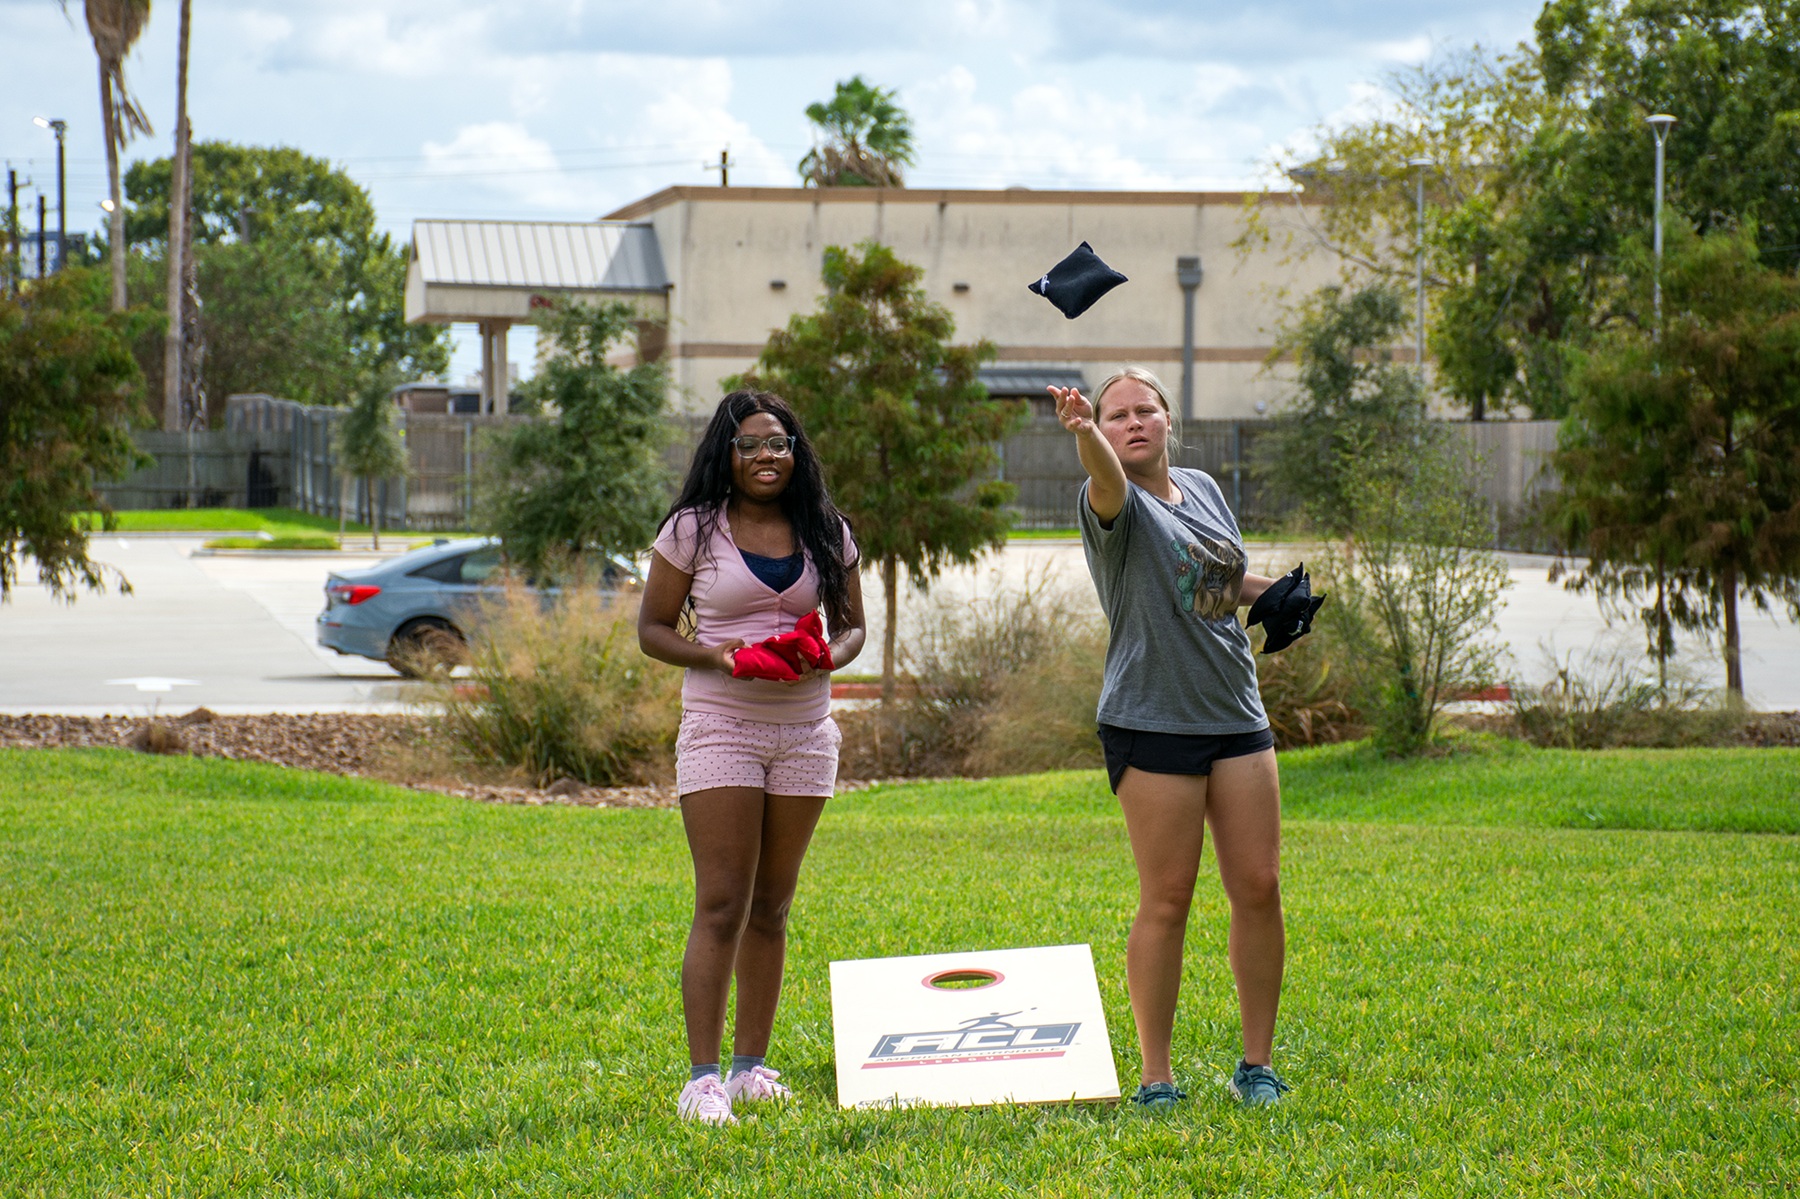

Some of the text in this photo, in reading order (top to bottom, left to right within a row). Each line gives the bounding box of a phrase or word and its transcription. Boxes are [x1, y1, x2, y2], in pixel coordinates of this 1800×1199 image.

[890, 1027, 1062, 1054] ACL
[874, 1047, 1060, 1062] AMERICAN CORNHOLE
[919, 1055, 1011, 1065] LEAGUE
